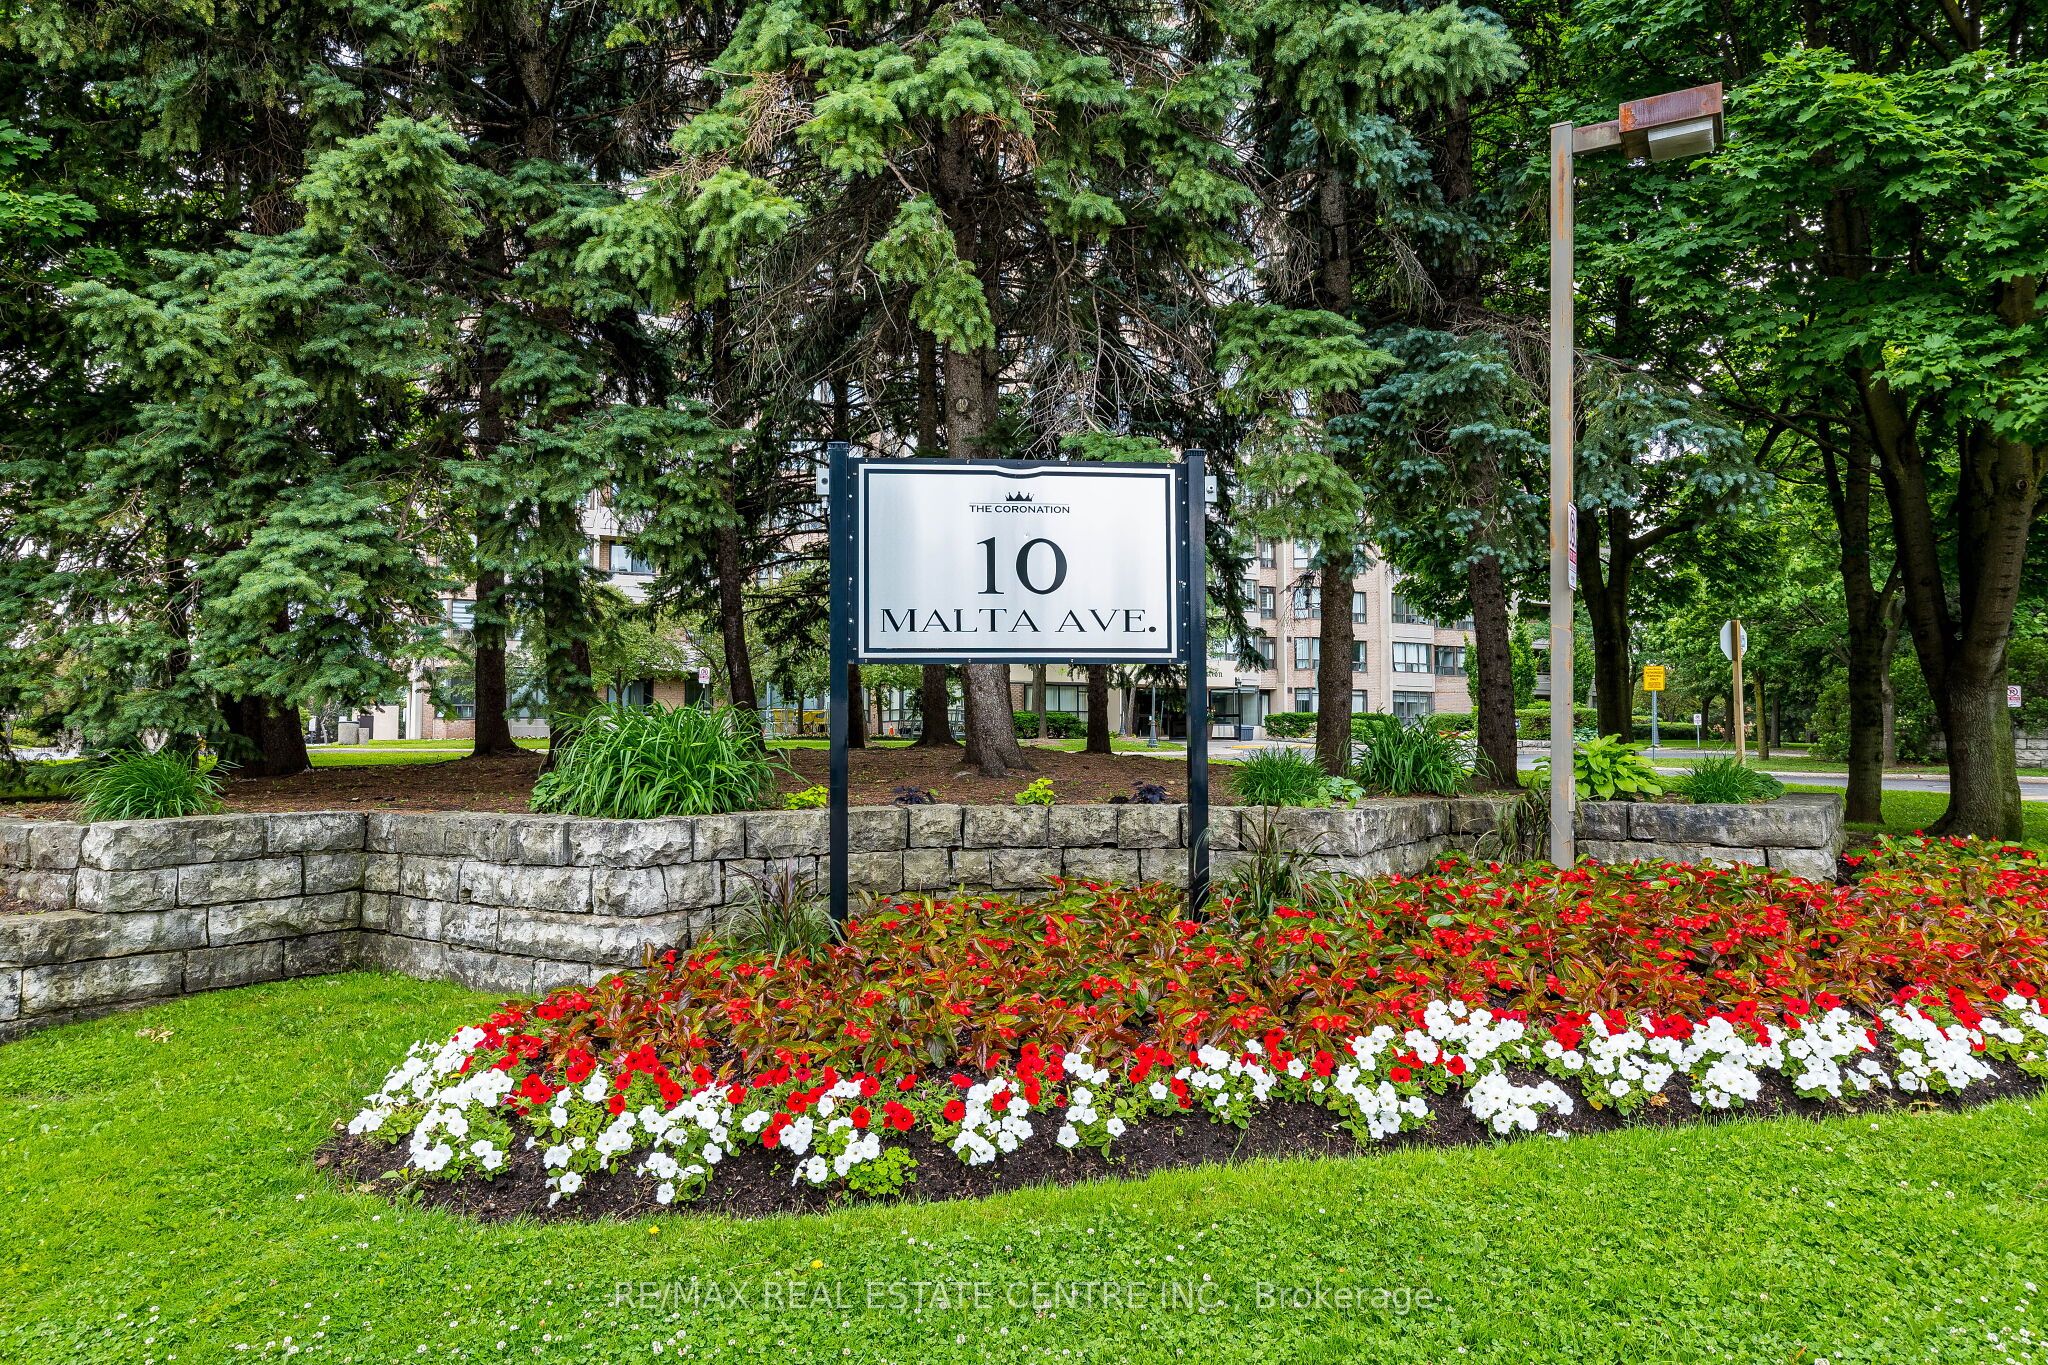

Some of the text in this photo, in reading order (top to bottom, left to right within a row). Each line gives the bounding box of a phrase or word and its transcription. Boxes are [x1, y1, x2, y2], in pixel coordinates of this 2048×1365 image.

[969, 504, 1070, 514] THE CORONATION
[977, 537, 1067, 595] 10
[881, 608, 1157, 633] MALTA AVE.
